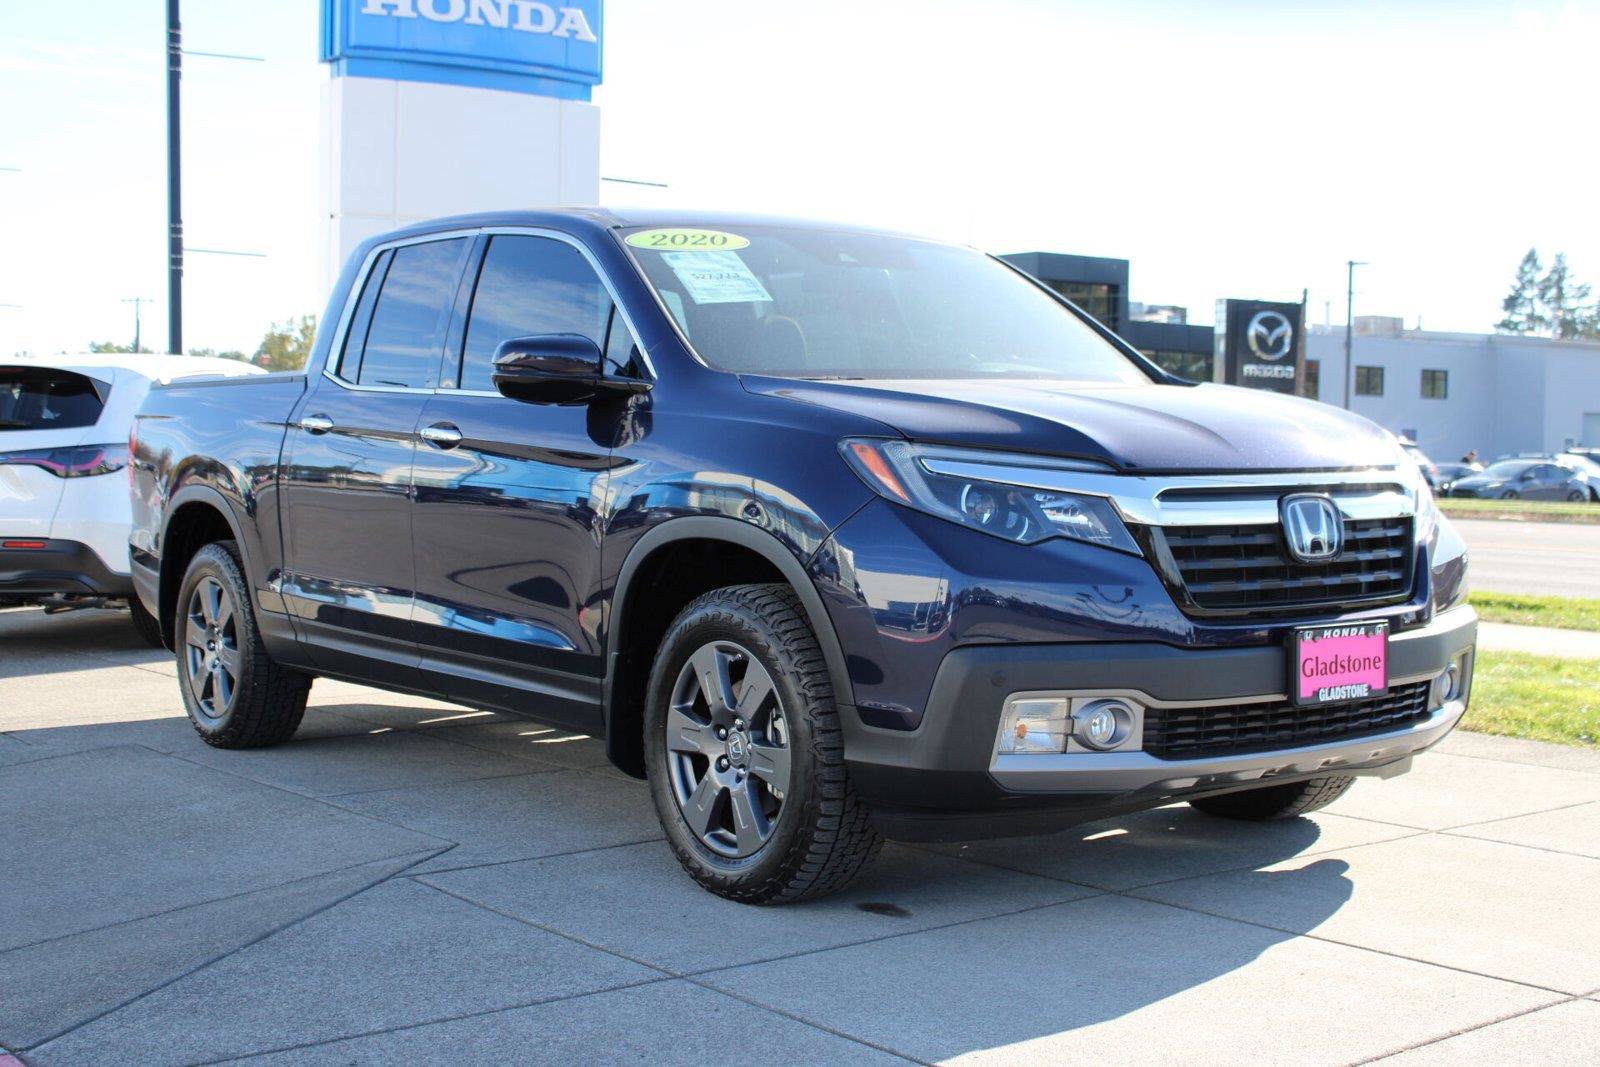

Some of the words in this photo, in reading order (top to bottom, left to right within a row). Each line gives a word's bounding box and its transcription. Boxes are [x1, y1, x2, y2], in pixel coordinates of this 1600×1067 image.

[651, 233, 728, 246] 2020
[1243, 364, 1295, 379] mazda
[1323, 627, 1365, 639] HONDA
[1302, 654, 1381, 678] Gladstone
[1319, 684, 1369, 701] GLADSTONE
